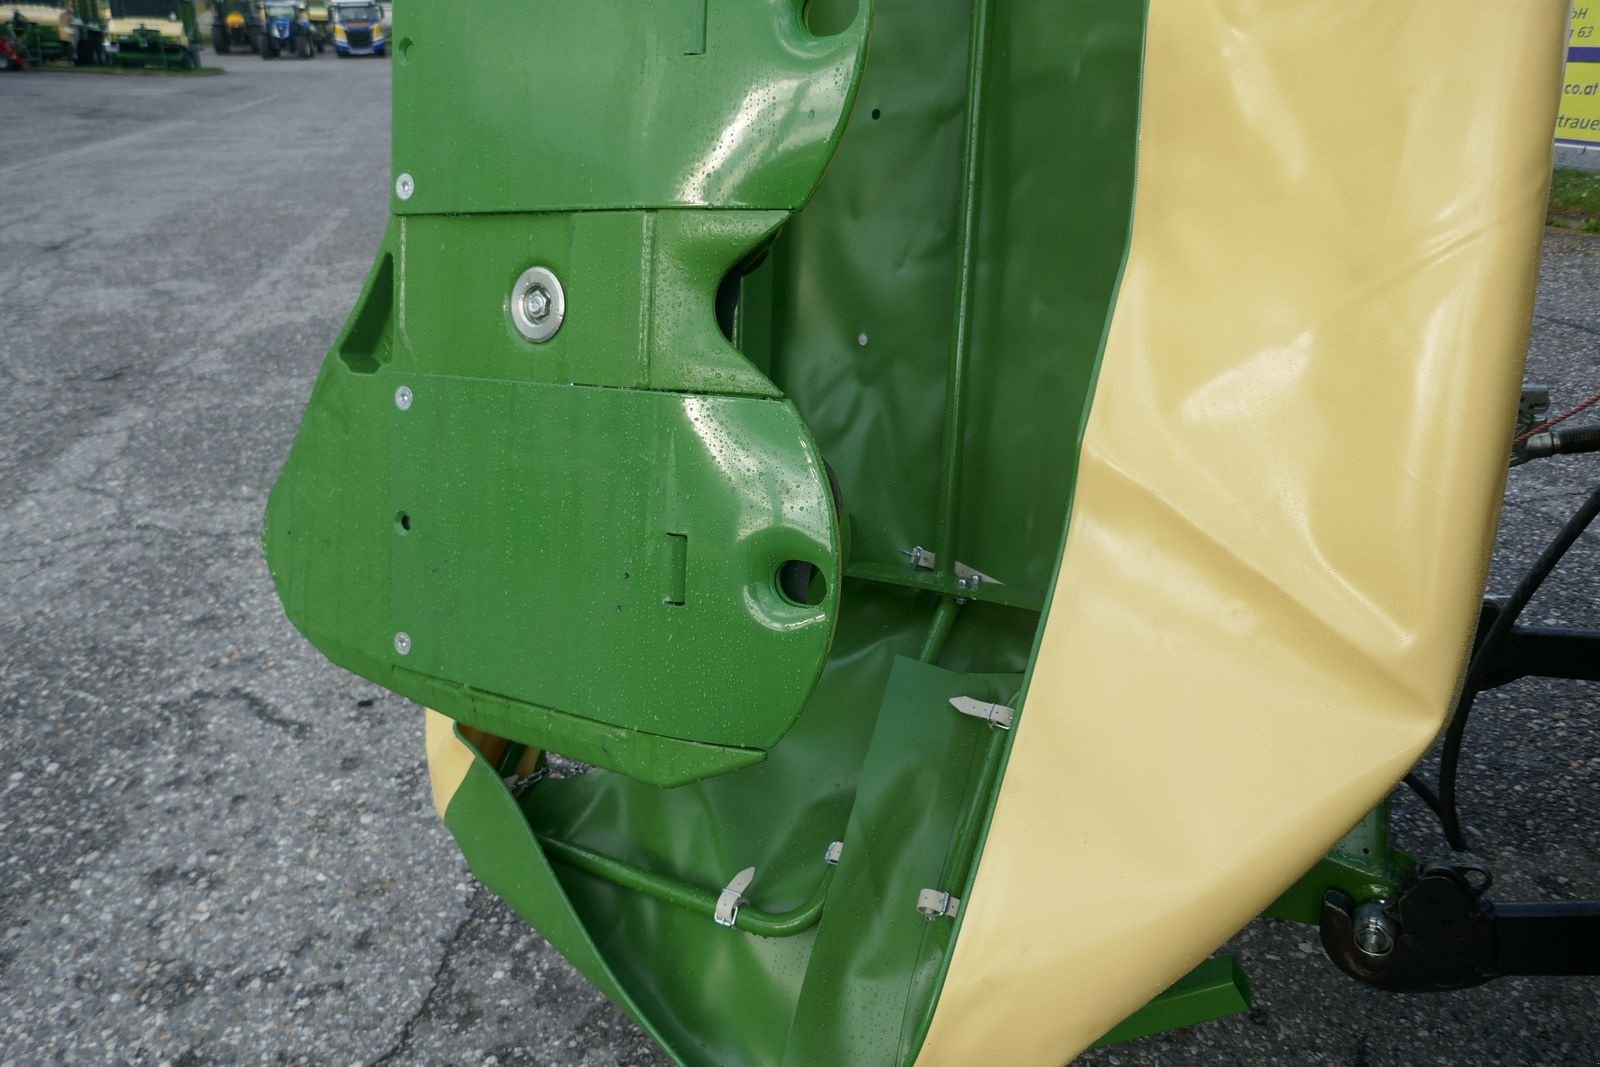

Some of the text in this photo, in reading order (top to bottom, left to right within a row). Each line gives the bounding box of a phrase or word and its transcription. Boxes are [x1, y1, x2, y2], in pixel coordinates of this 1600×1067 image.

[1577, 27, 1594, 38] 63
[1564, 82, 1599, 95] co.at
[1557, 114, 1600, 130] traue
